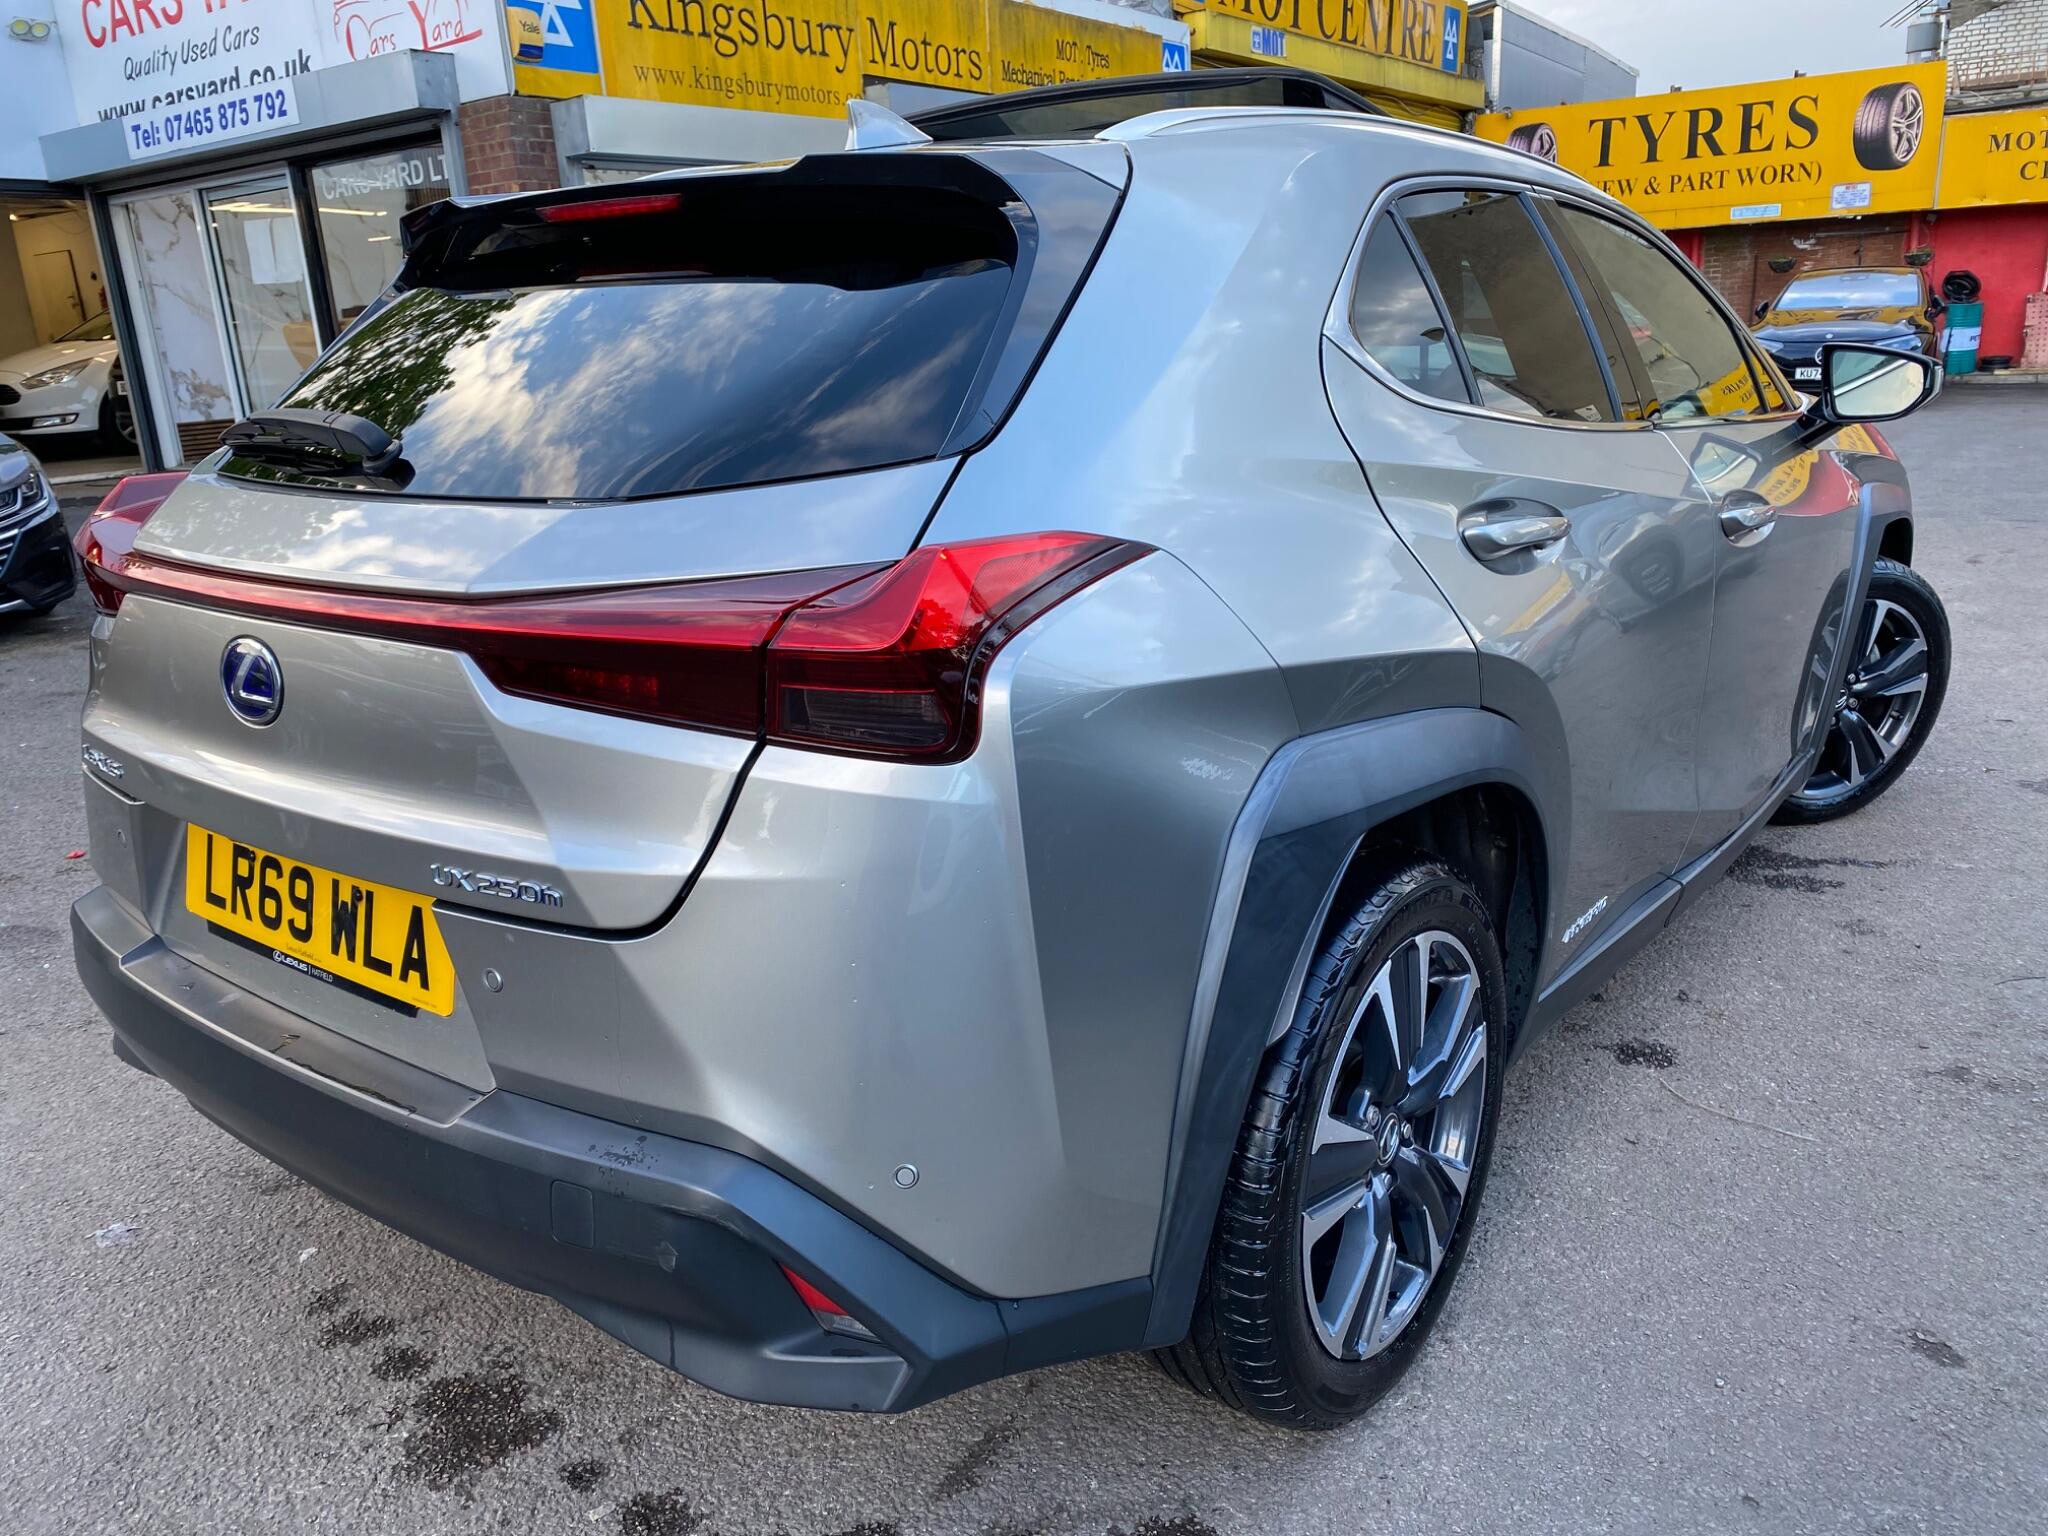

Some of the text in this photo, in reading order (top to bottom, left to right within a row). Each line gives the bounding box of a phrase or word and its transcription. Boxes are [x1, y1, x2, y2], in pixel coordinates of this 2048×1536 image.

[346, 0, 466, 61] Cars Yard
[520, 20, 540, 35] Yale
[627, 0, 983, 81] Kingsbury Motors
[1262, 28, 1285, 56] MOT
[1317, 0, 1437, 64] CENTRE
[124, 25, 260, 81] Quality Used Cars
[1001, 60, 1055, 87] Mechanical
[1056, 39, 1109, 72] MOT Tyres
[97, 48, 311, 122] wwwcarsyardcouk
[131, 89, 288, 149] Tel: 07465 875 792
[1588, 95, 1820, 168] TYRES
[376, 160, 424, 190] YARD
[1596, 161, 1822, 197] EW & PART WORN)
[1800, 369, 1822, 378] KU7
[205, 833, 430, 991] LR69 WLA
[281, 955, 334, 983] LEXUS HATFIELD
